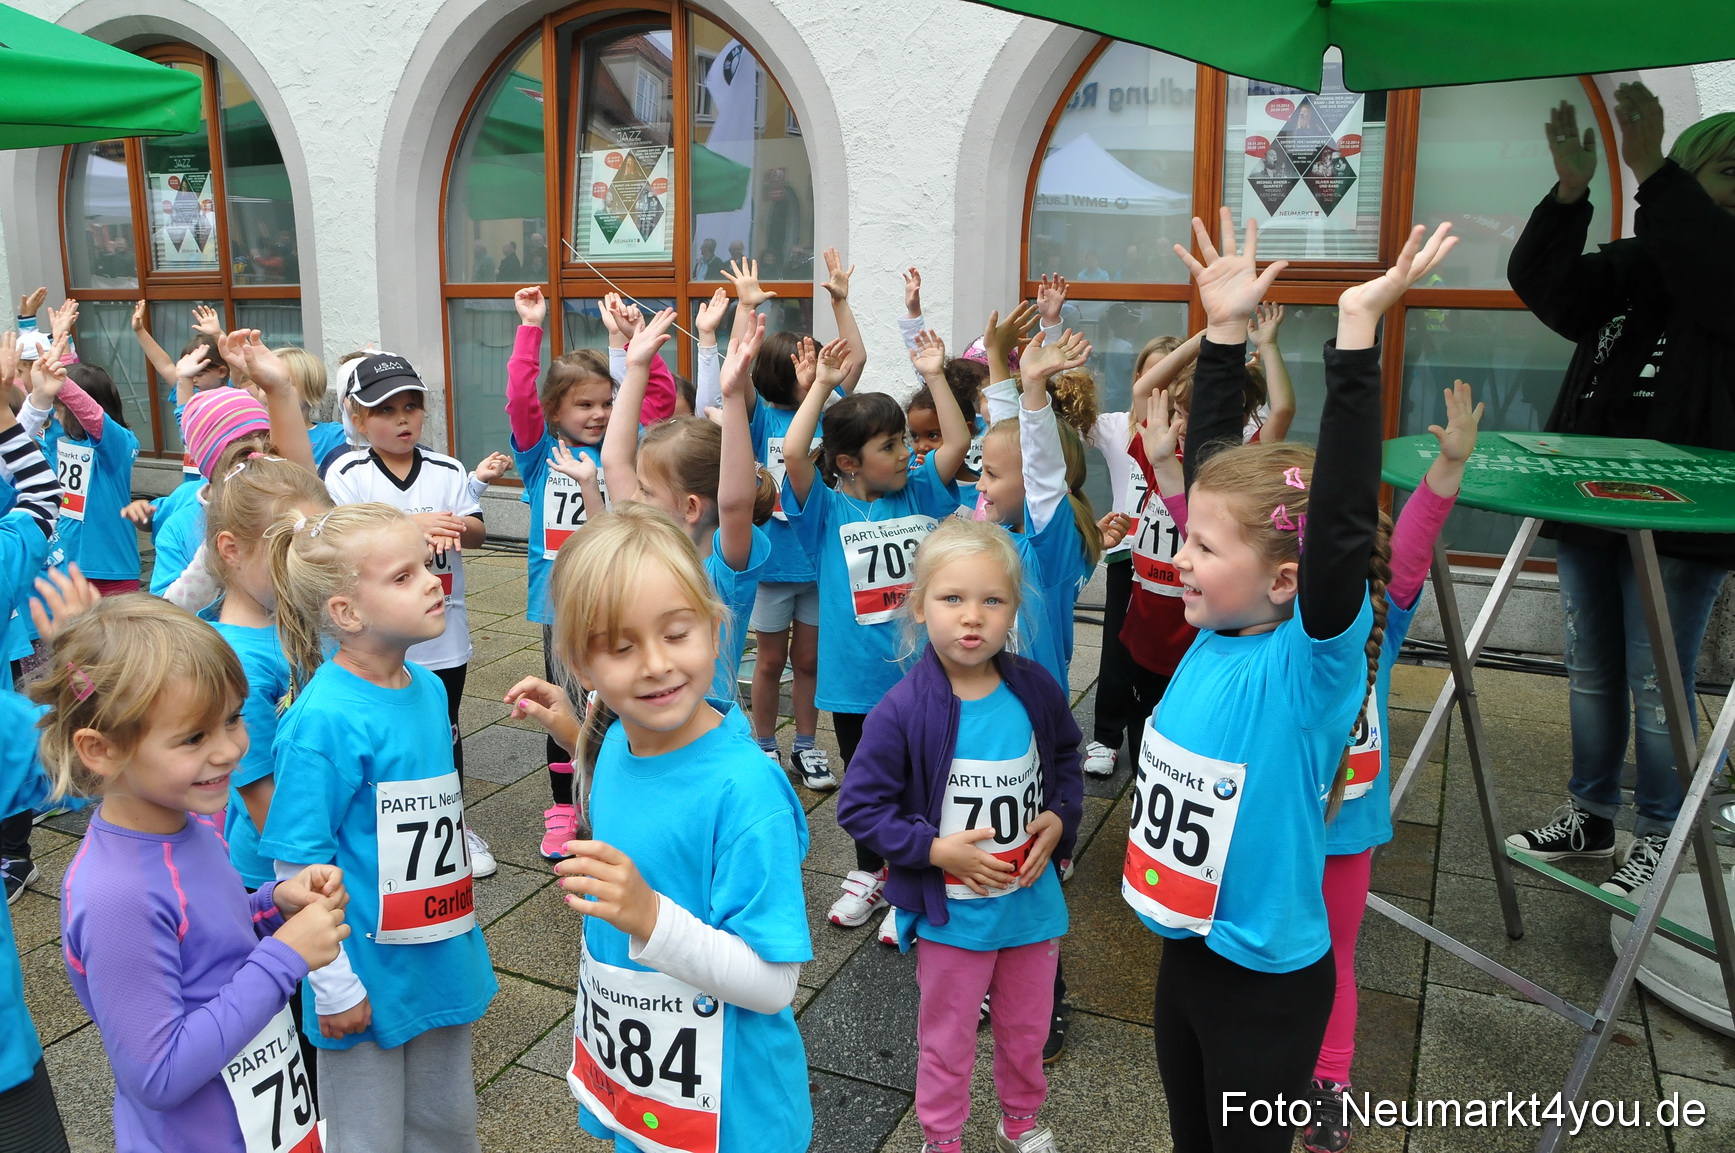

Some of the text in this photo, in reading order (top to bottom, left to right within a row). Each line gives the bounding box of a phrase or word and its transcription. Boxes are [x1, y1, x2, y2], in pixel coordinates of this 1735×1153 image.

[616, 130, 642, 143] JAZZ
[173, 158, 191, 169] JAZZ
[59, 460, 83, 490] 28
[1130, 473, 1145, 481] PAR
[843, 528, 880, 545] PARTL
[1138, 515, 1180, 558] 711
[1148, 564, 1174, 582] Jana
[1142, 740, 1205, 792] Neumarkt
[381, 796, 437, 814] PARTL
[397, 811, 468, 882] 721
[1205, 868, 1213, 879] K
[592, 976, 683, 1013] Neumarkt
[227, 1037, 288, 1082] PARTL
[251, 1050, 312, 1151] 75
[702, 1096, 710, 1107] K
